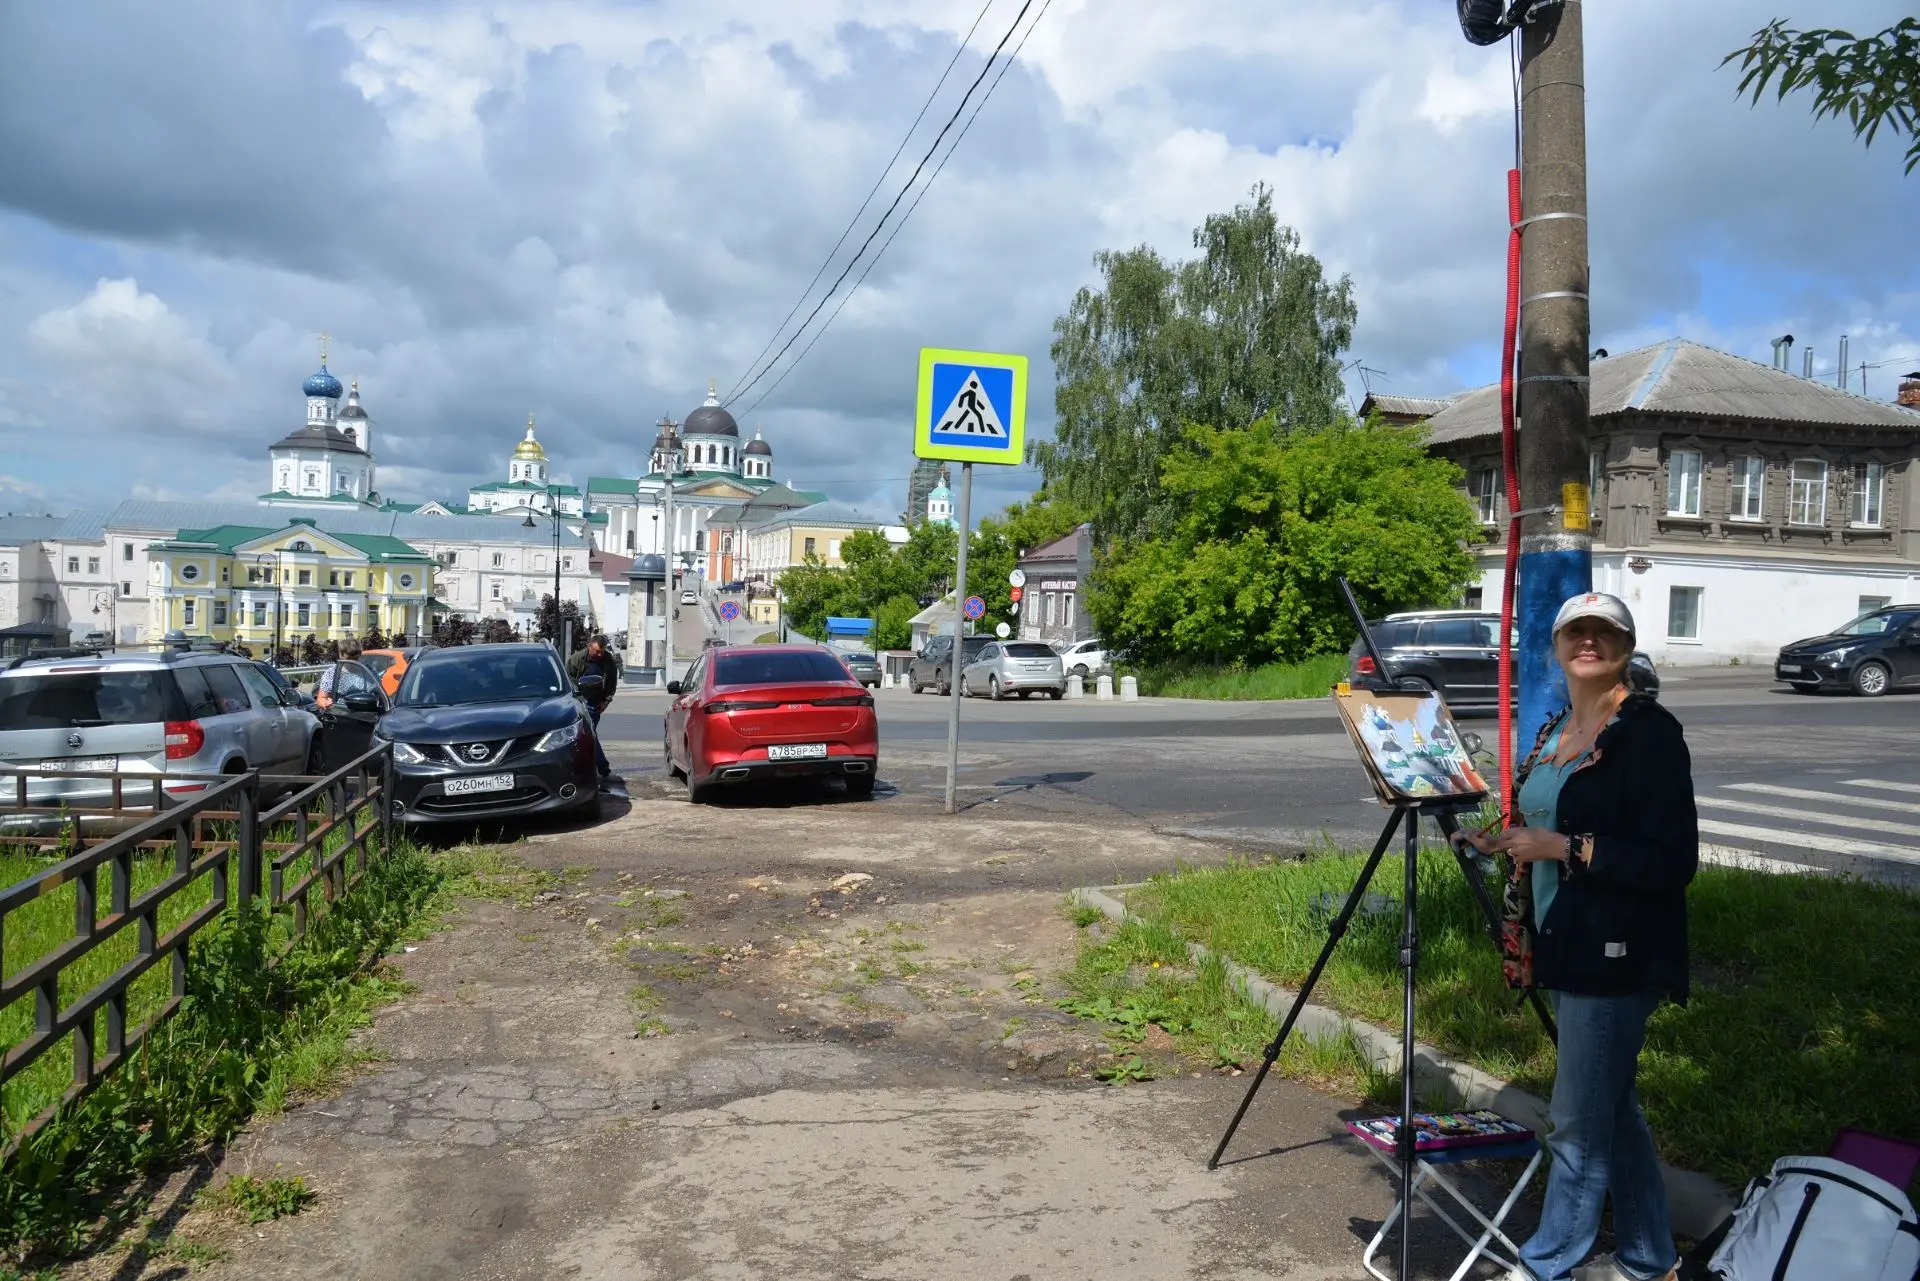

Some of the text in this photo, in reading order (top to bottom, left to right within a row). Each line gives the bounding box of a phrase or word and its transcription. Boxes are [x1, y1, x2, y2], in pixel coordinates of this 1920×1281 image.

[772, 744, 824, 757] А785ВР 252
[447, 775, 511, 791] О260МН 152
